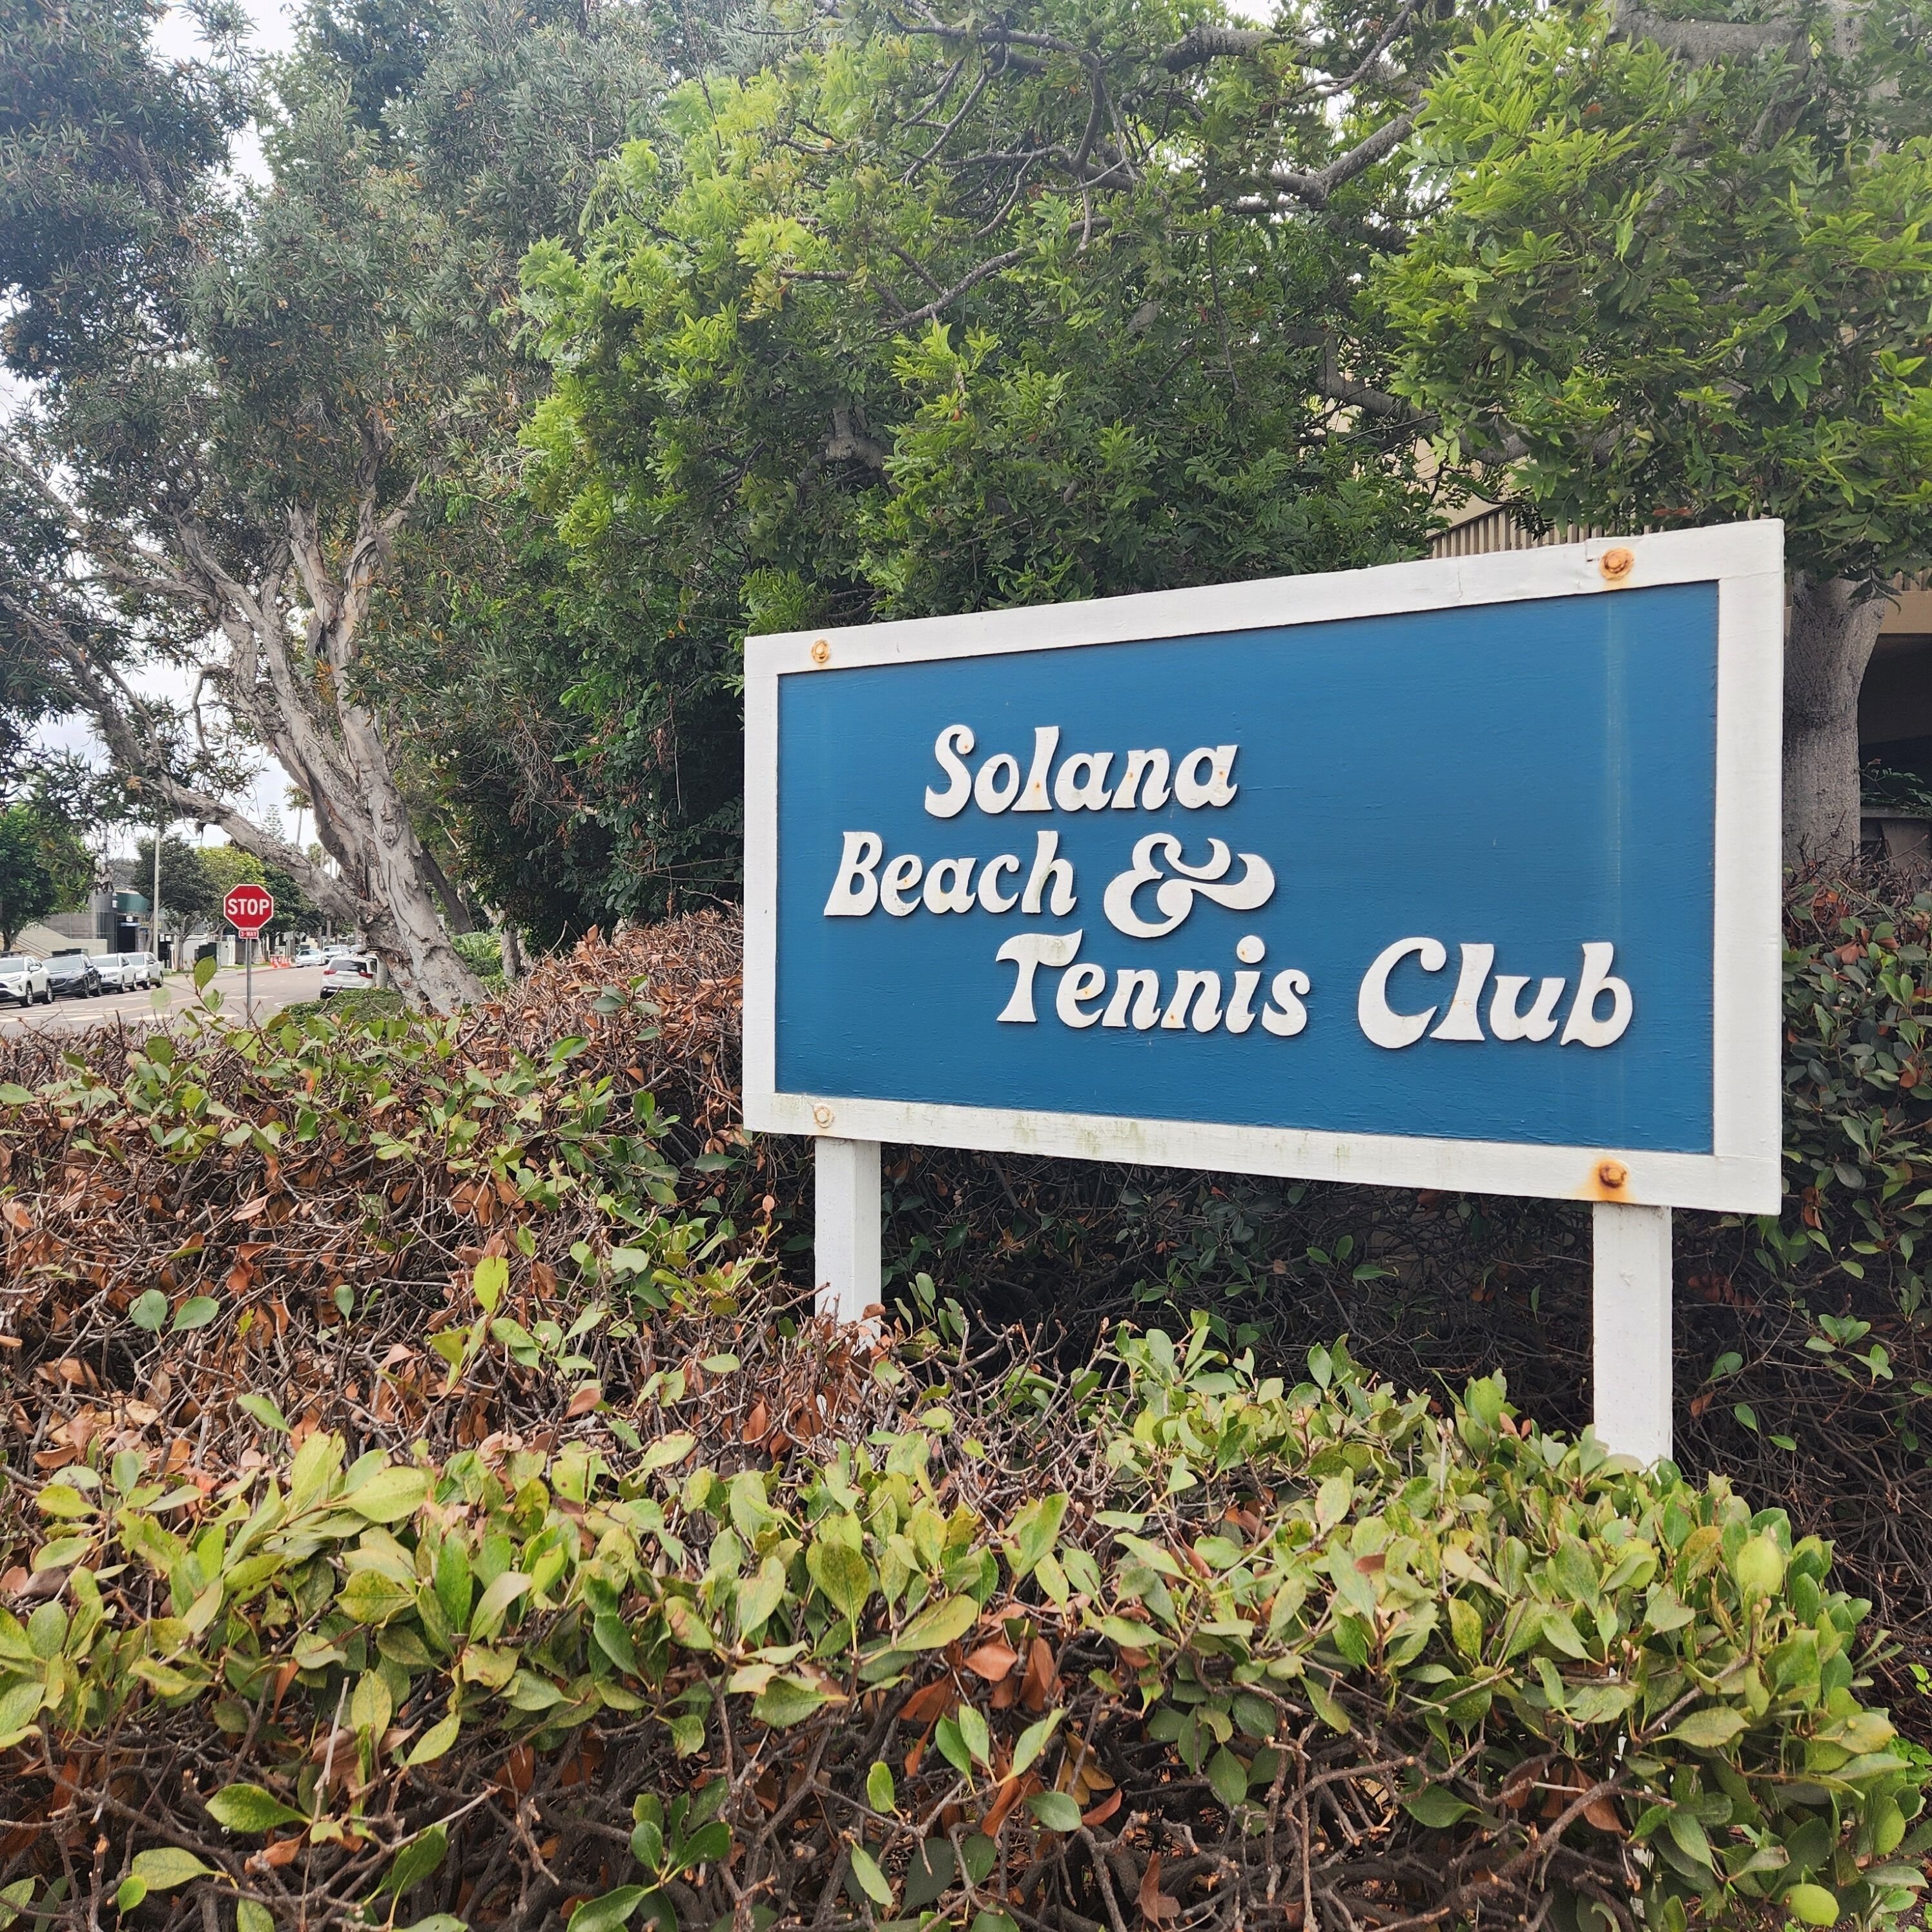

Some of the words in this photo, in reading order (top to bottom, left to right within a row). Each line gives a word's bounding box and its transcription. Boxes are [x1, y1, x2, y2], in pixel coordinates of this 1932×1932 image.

[924, 724, 1238, 818] Solana
[227, 898, 270, 916] STOP
[823, 830, 1078, 917] Beach
[1103, 832, 1275, 939] &
[995, 929, 1310, 1037] Tennis
[1357, 936, 1633, 1049] Club
